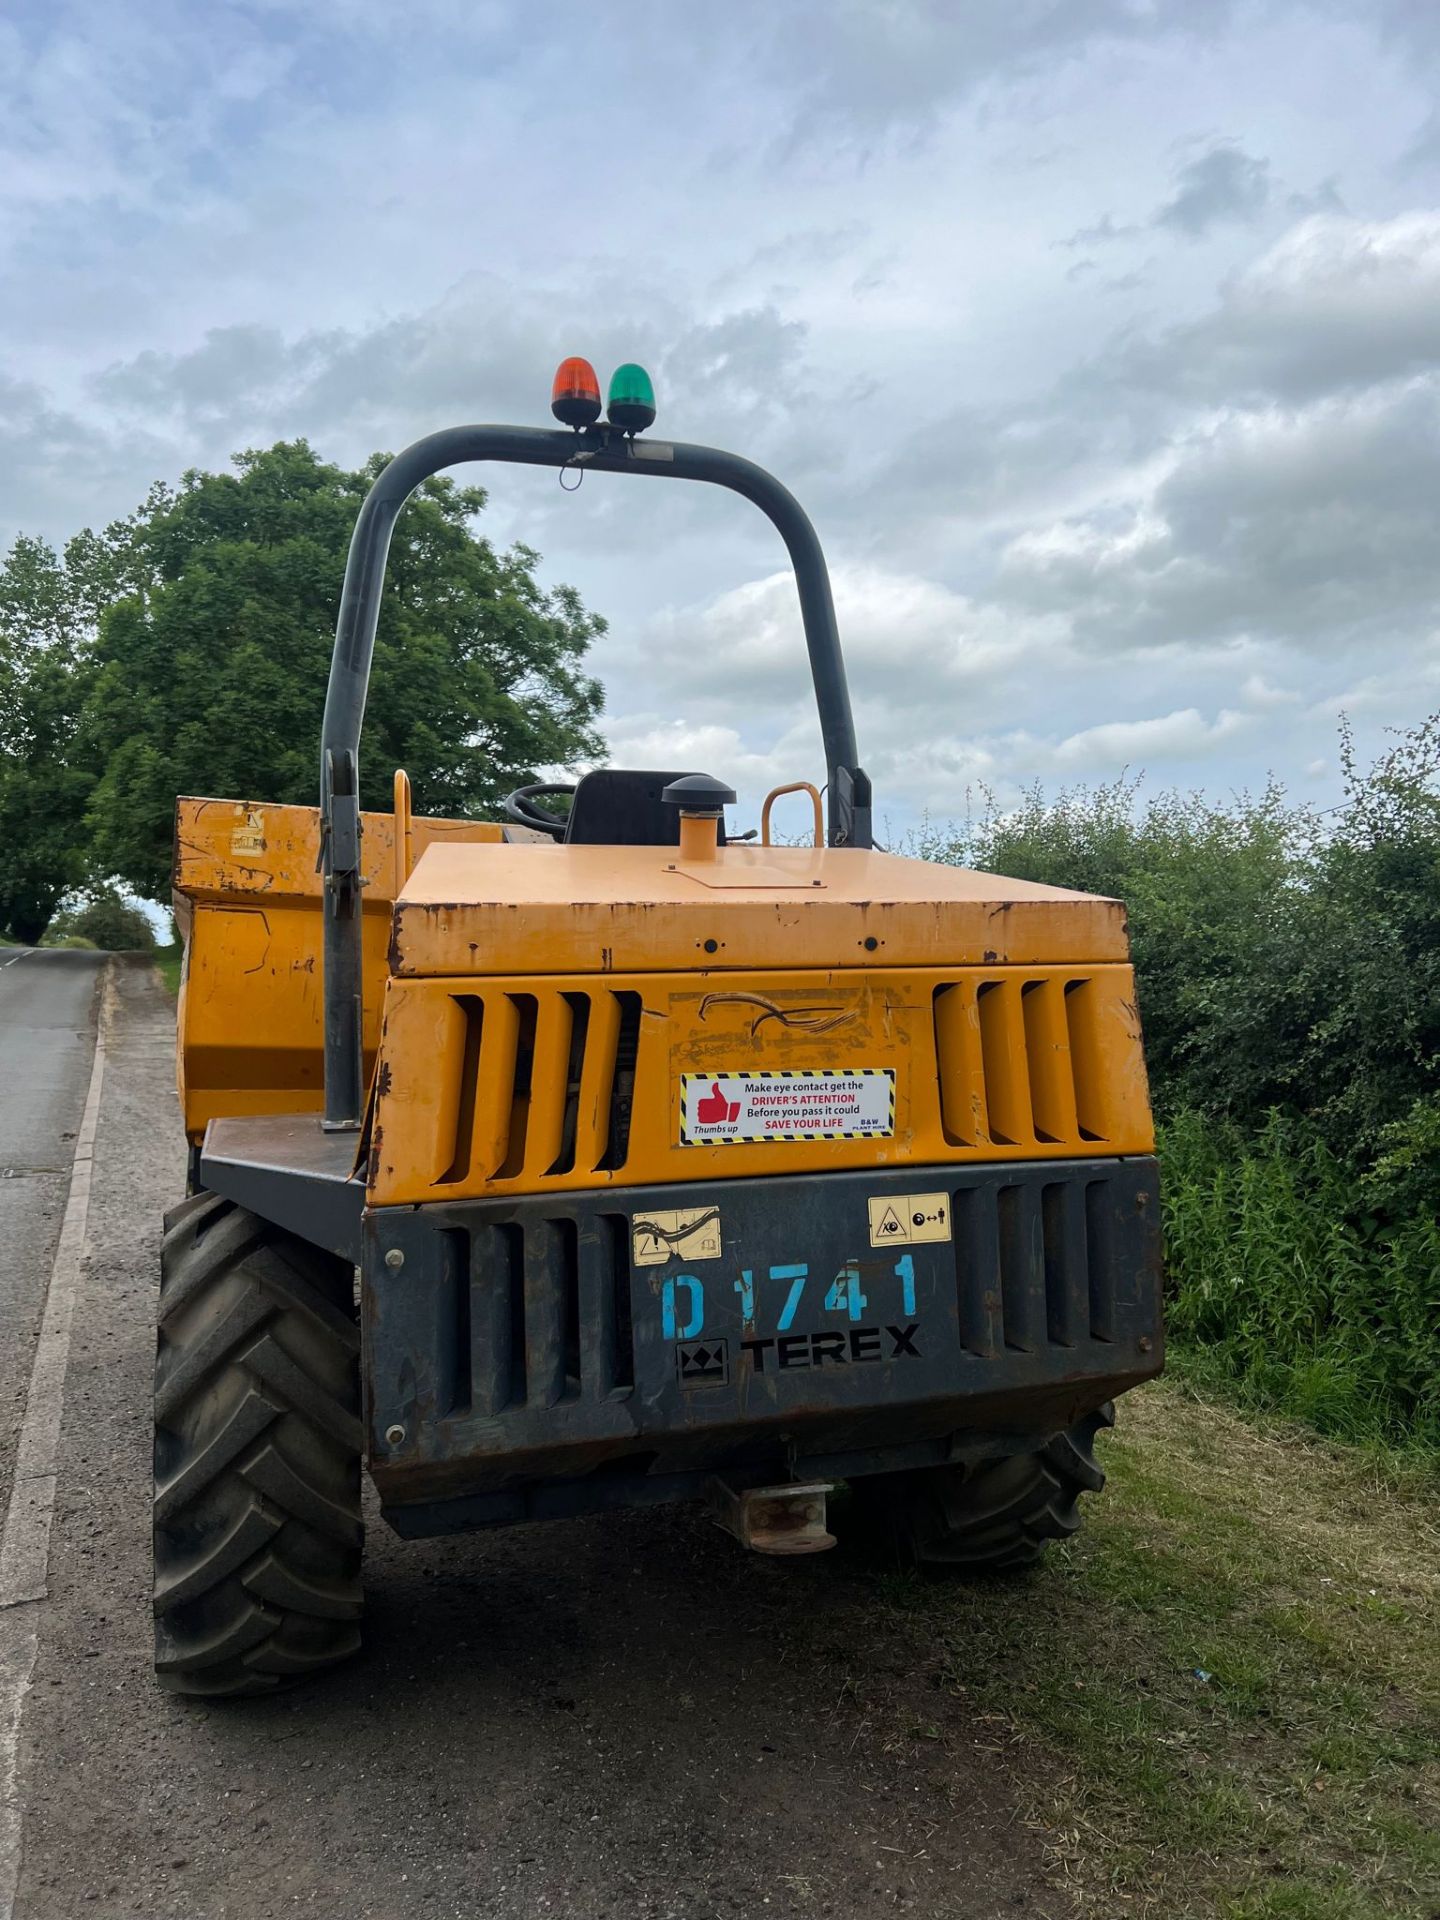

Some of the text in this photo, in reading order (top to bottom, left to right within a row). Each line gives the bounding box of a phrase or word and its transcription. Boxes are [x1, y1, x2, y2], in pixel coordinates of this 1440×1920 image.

[745, 1081, 864, 1094] Make eye contact get the
[752, 1094, 855, 1106] DRIVER'S ATTENTION
[748, 1105, 860, 1118] Before you pass it could
[694, 1125, 726, 1133] Thumbs
[765, 1119, 843, 1129] SAVE YOUR LIFE
[740, 1323, 922, 1372] TEREX
